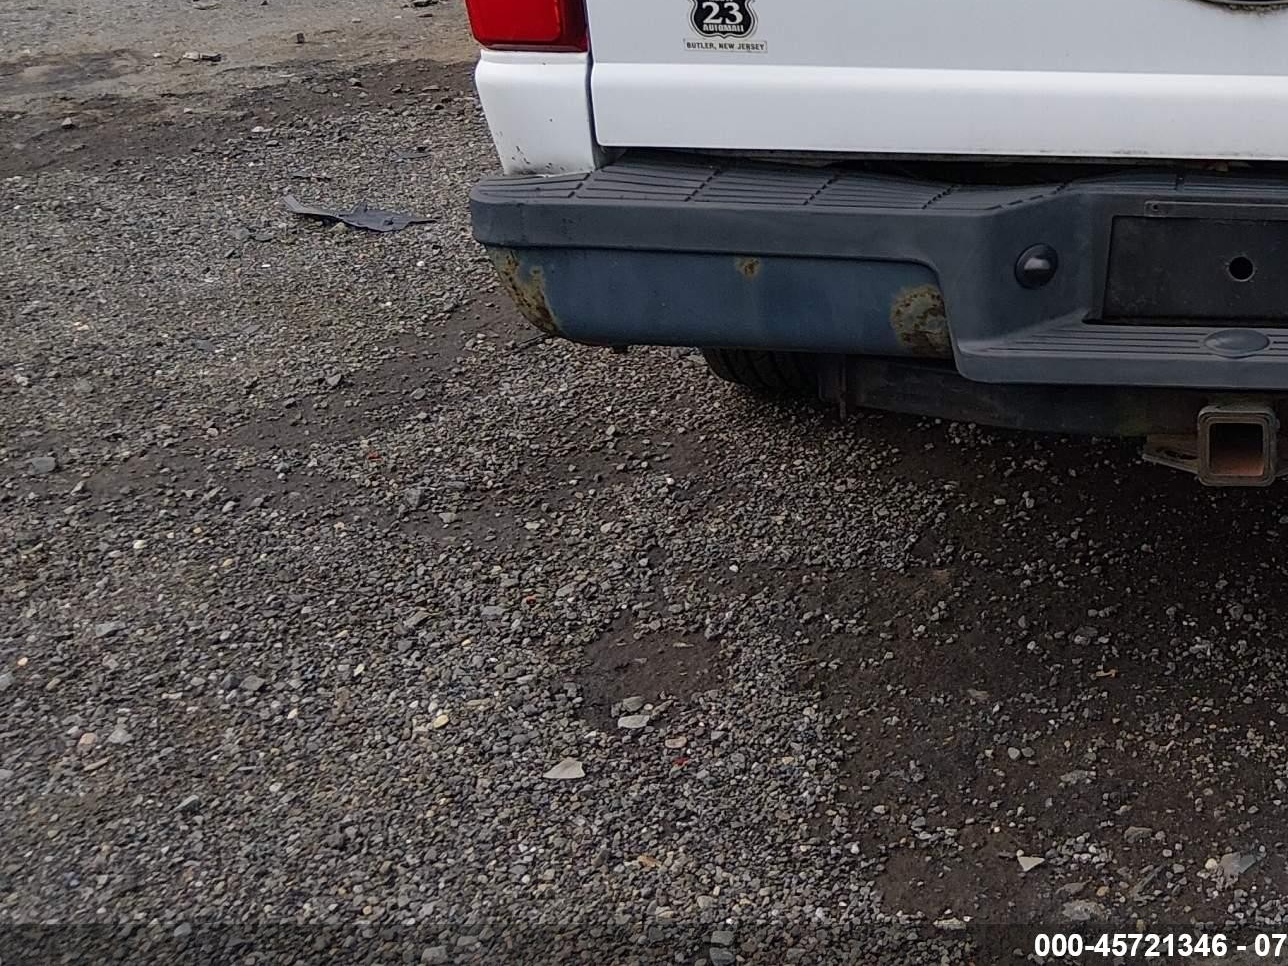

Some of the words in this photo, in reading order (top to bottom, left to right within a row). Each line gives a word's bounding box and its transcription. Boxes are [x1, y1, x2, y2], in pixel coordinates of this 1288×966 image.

[702, 1, 743, 24] 23
[702, 23, 745, 32] AUTOMALL
[686, 41, 717, 51] BUTLER,
[718, 42, 735, 51] NEW
[737, 42, 765, 51] JERSEY
